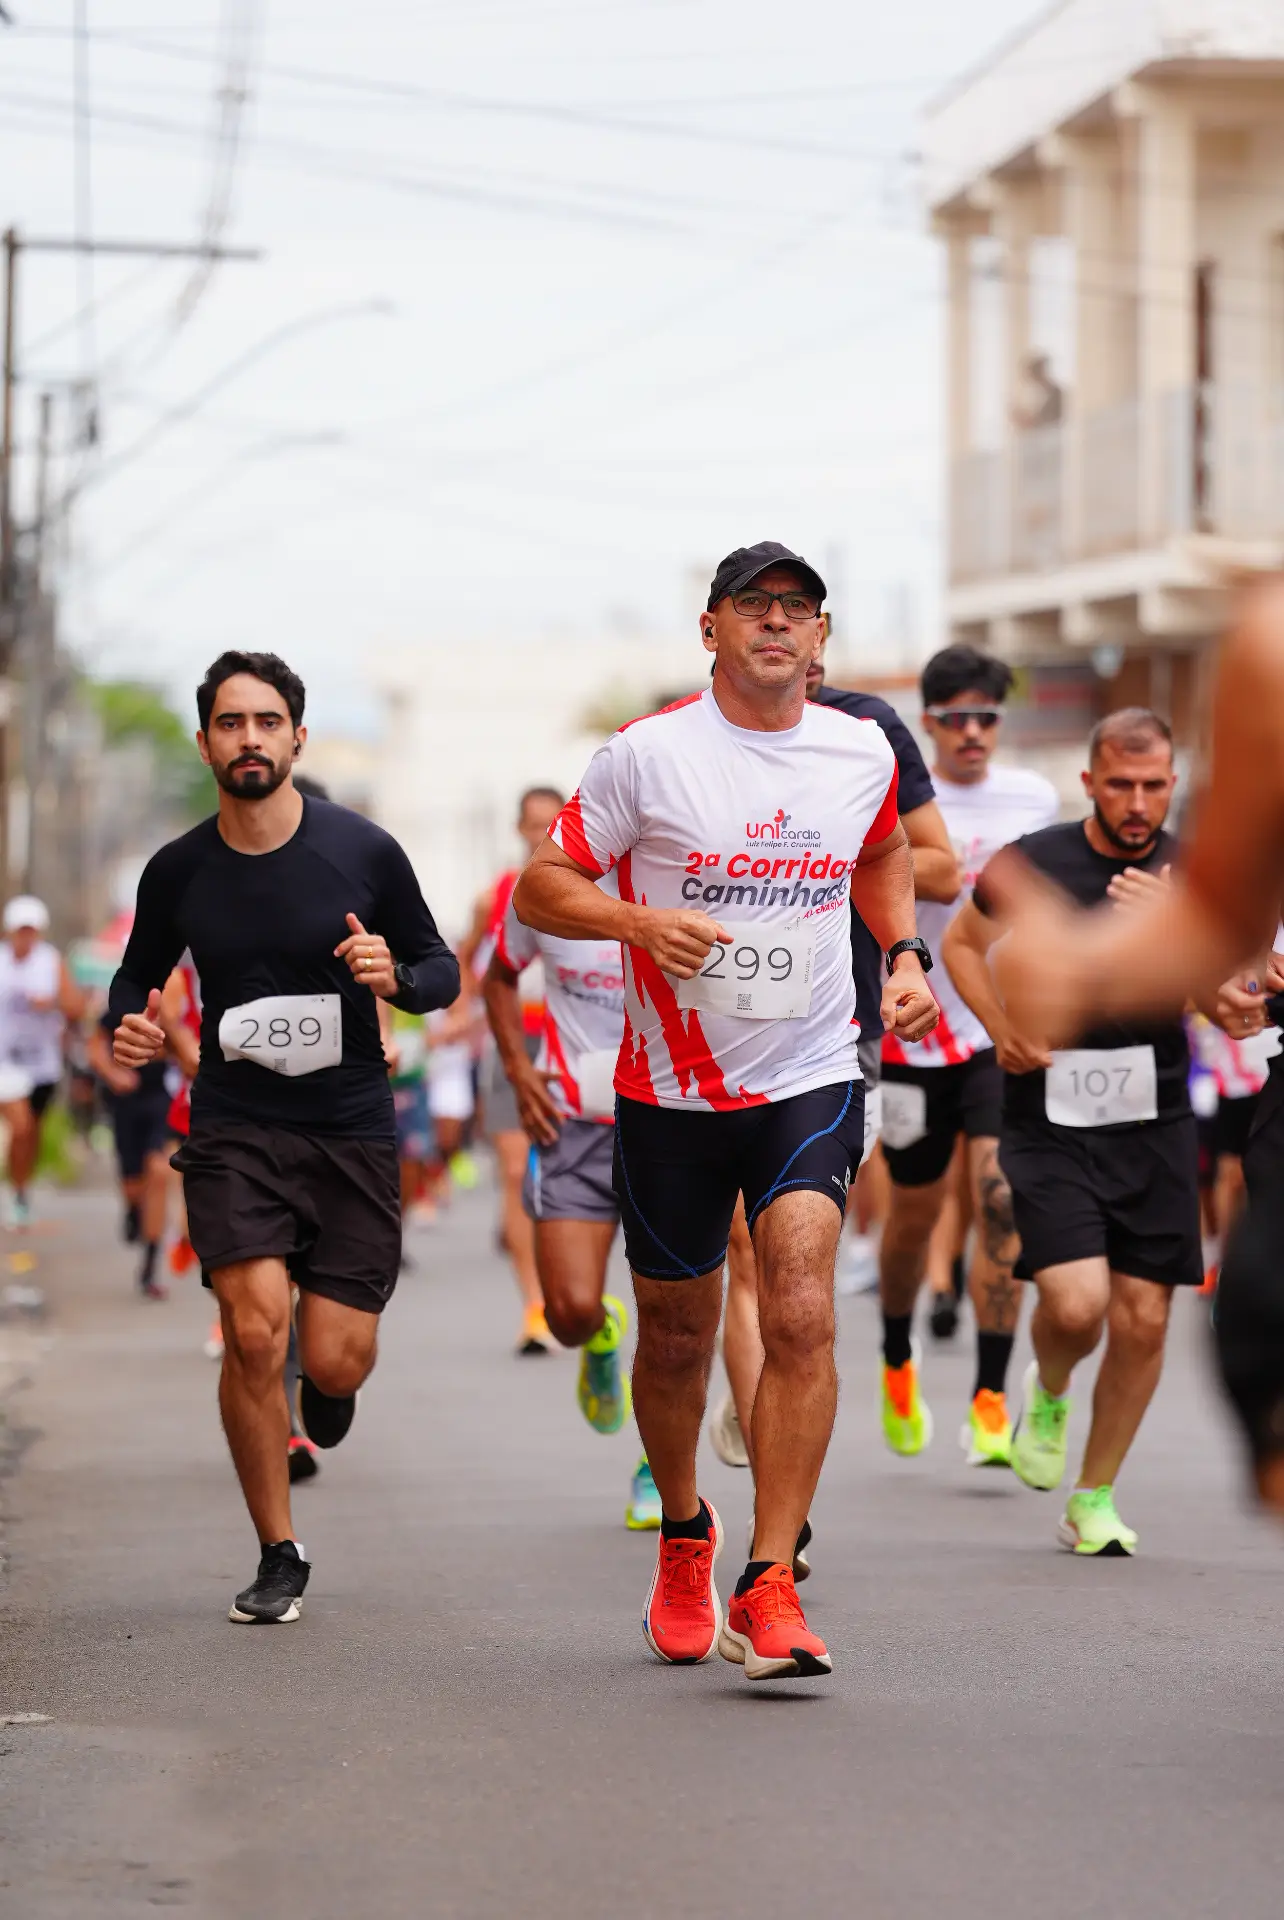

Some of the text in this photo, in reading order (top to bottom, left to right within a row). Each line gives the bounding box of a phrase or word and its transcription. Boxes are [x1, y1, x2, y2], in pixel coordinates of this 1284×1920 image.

[726, 851, 848, 880] Corrida
[700, 943, 794, 982] 299
[239, 1016, 322, 1049] 289
[1068, 1067, 1133, 1098] 107
